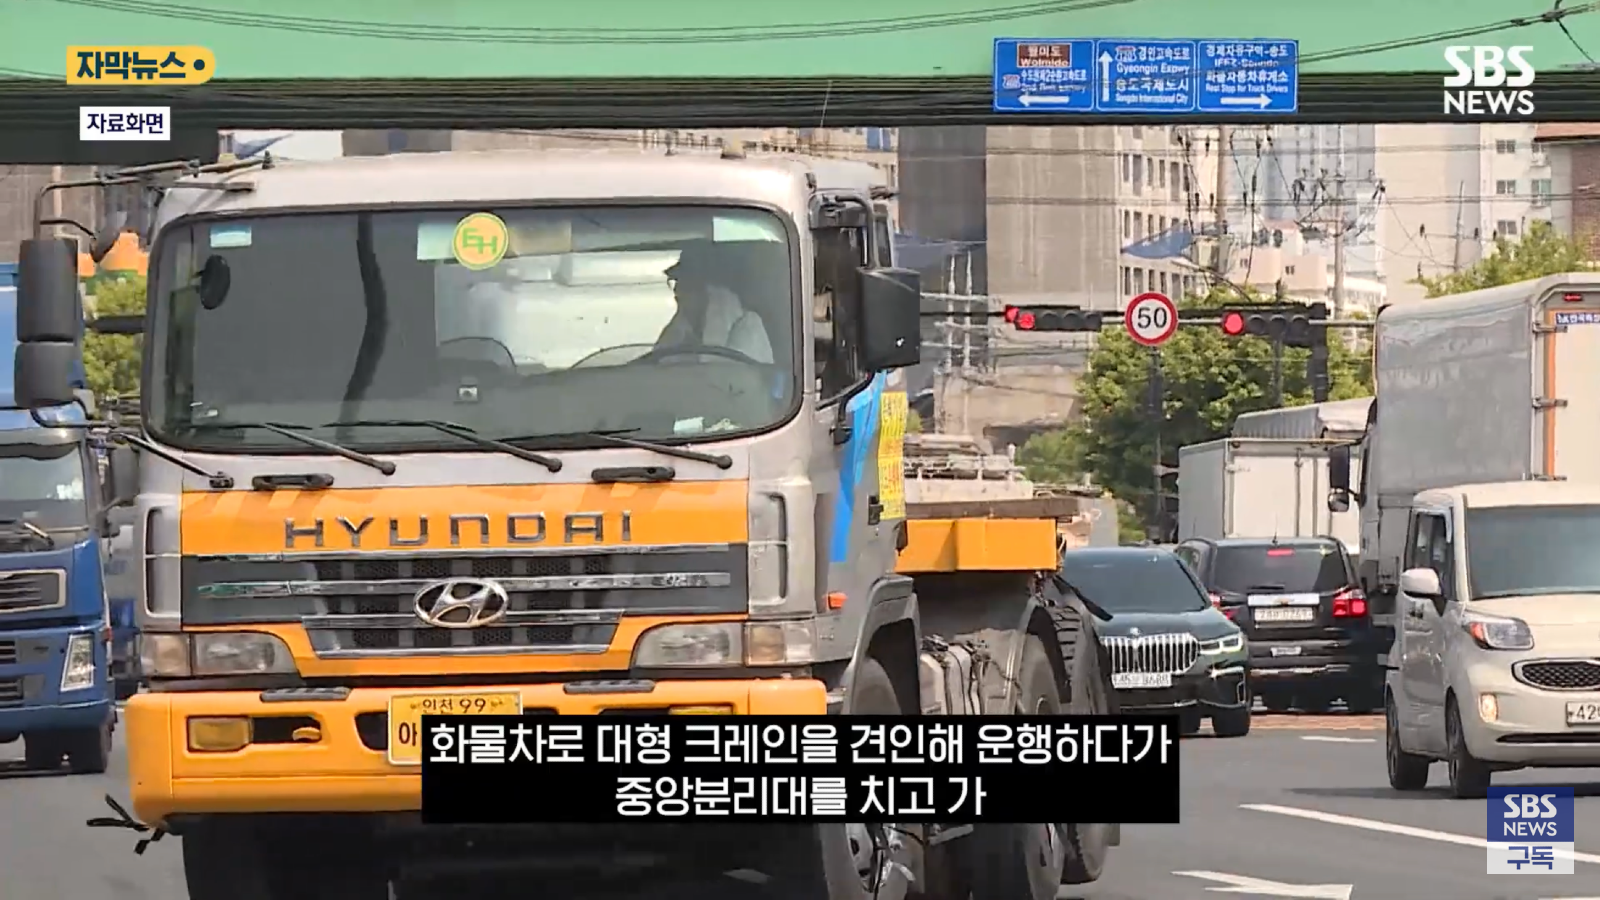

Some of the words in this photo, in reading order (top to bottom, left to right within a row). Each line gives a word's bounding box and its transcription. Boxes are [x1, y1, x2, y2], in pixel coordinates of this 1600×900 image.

[1137, 45, 1191, 61] 경인고속도로
[1020, 58, 1069, 67] Wolmido
[1116, 62, 1158, 75] Gyeongin
[1160, 62, 1190, 75] Expwy
[1137, 306, 1168, 329] 50
[284, 511, 632, 549] HYUNDAI
[459, 698, 486, 714] 99
